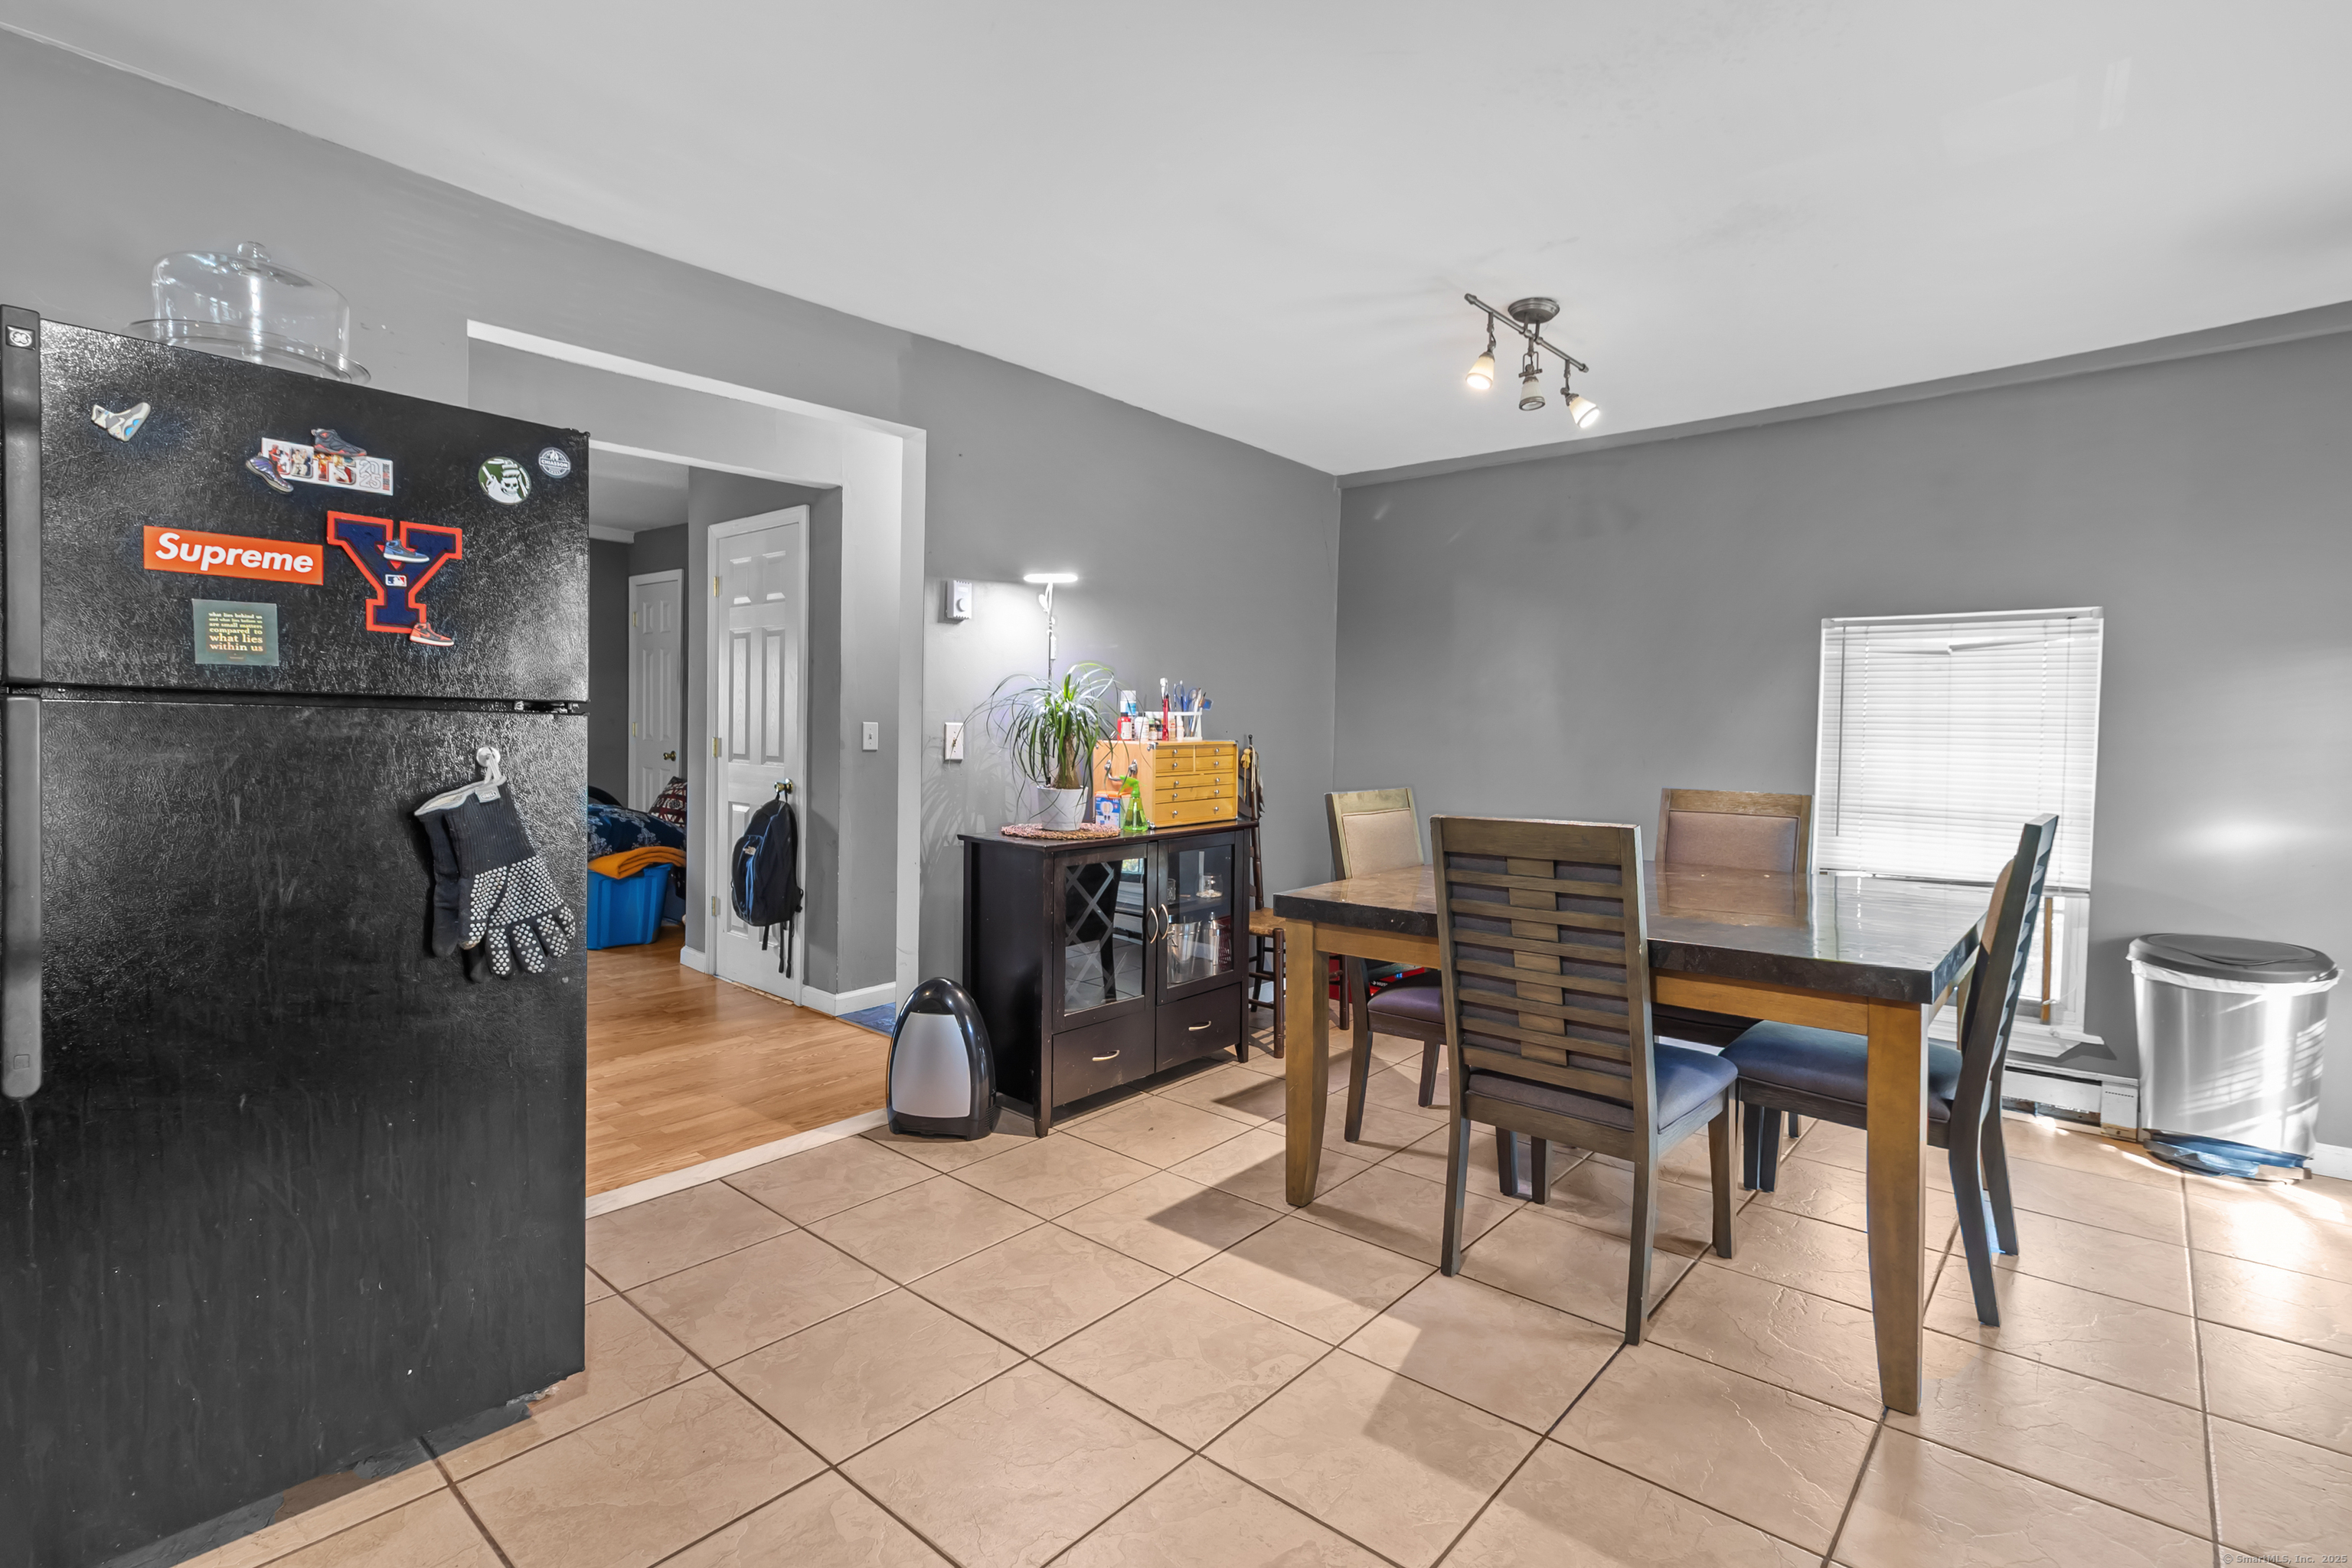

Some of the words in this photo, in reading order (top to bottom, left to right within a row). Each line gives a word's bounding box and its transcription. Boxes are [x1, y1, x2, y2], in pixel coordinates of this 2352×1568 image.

[541, 459, 568, 468] CHIASSON
[155, 532, 314, 573] Supreme
[327, 511, 462, 634] Y
[209, 632, 239, 642] what
[242, 633, 263, 643] lies
[209, 642, 248, 652] within
